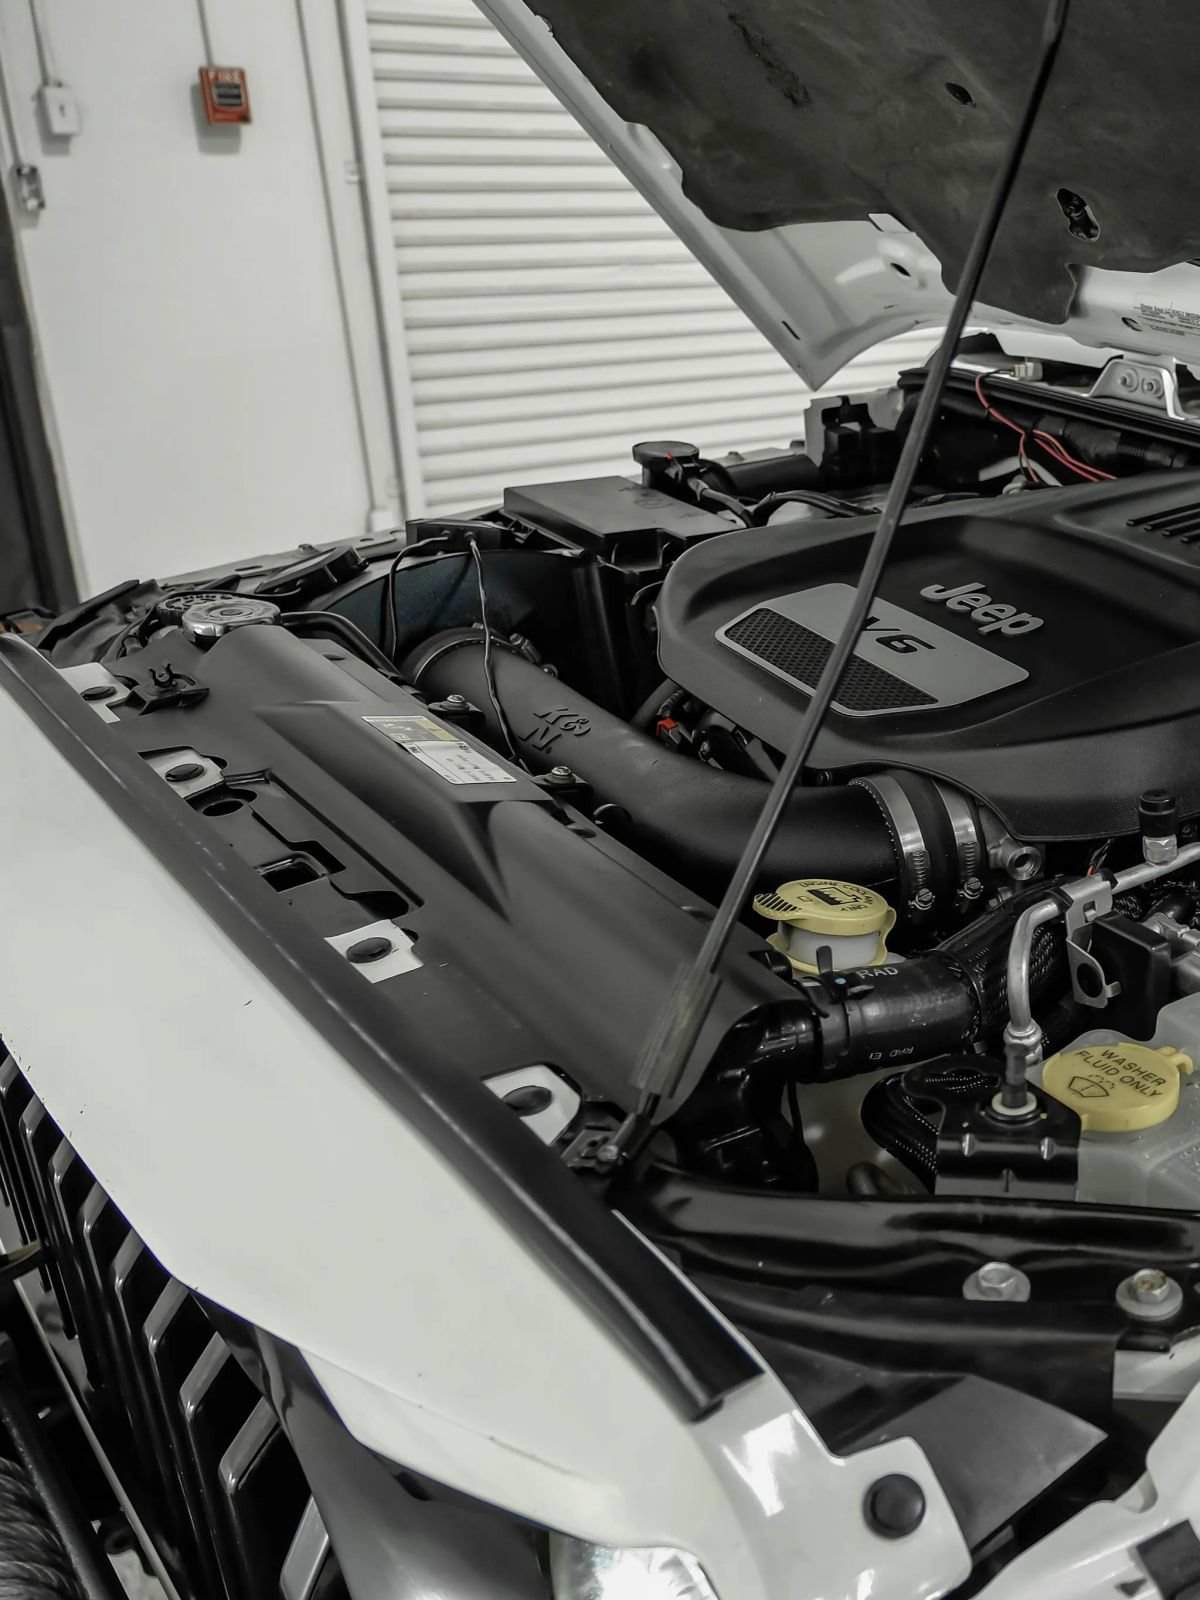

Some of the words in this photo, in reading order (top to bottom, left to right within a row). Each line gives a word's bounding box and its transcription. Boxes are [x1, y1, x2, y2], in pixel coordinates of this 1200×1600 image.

[920, 582, 1045, 637] Jeep
[859, 615, 937, 654] V6
[856, 966, 899, 980] RAD
[1075, 1050, 1120, 1077] FLUID
[1119, 1074, 1163, 1098] ONLY
[1100, 1049, 1167, 1087] WASHER
